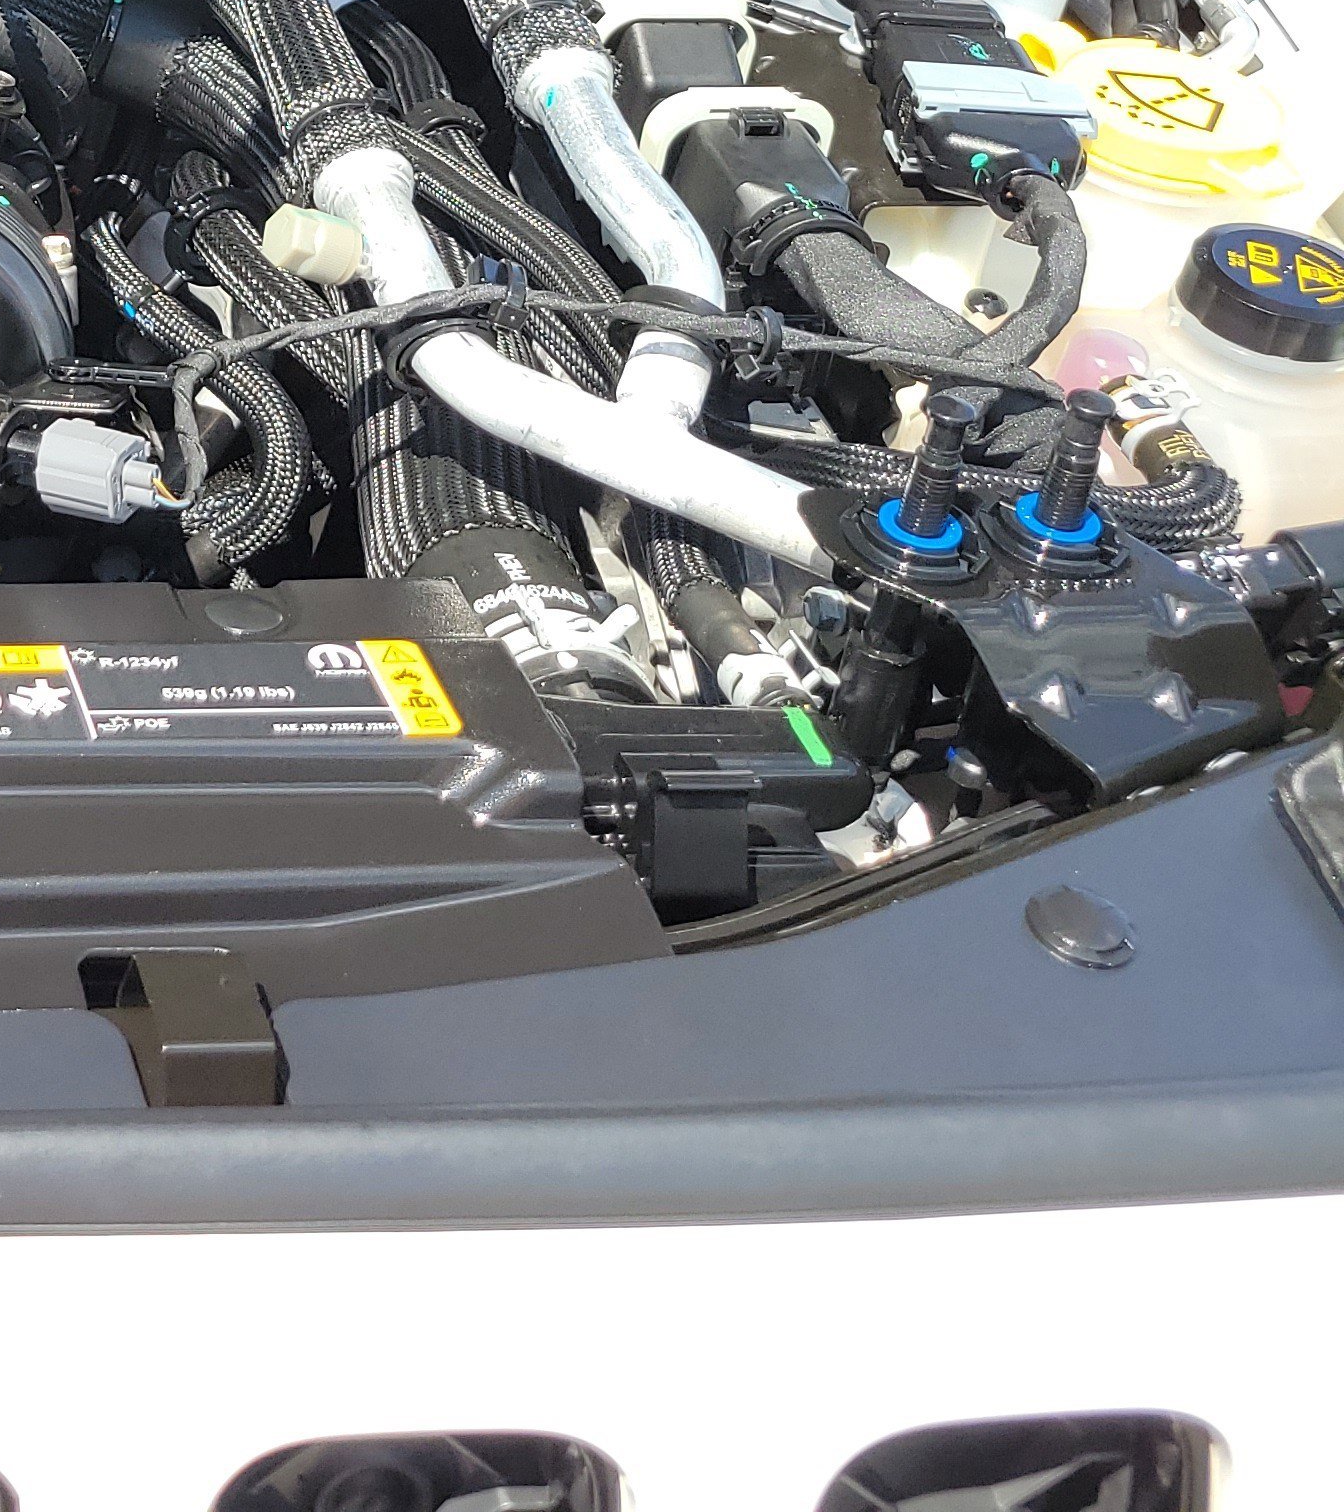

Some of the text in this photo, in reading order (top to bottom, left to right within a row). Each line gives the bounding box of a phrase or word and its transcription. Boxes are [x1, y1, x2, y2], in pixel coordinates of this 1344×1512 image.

[493, 552, 532, 582] PHEV
[98, 655, 180, 672] R-1234yf
[133, 717, 172, 730] POE
